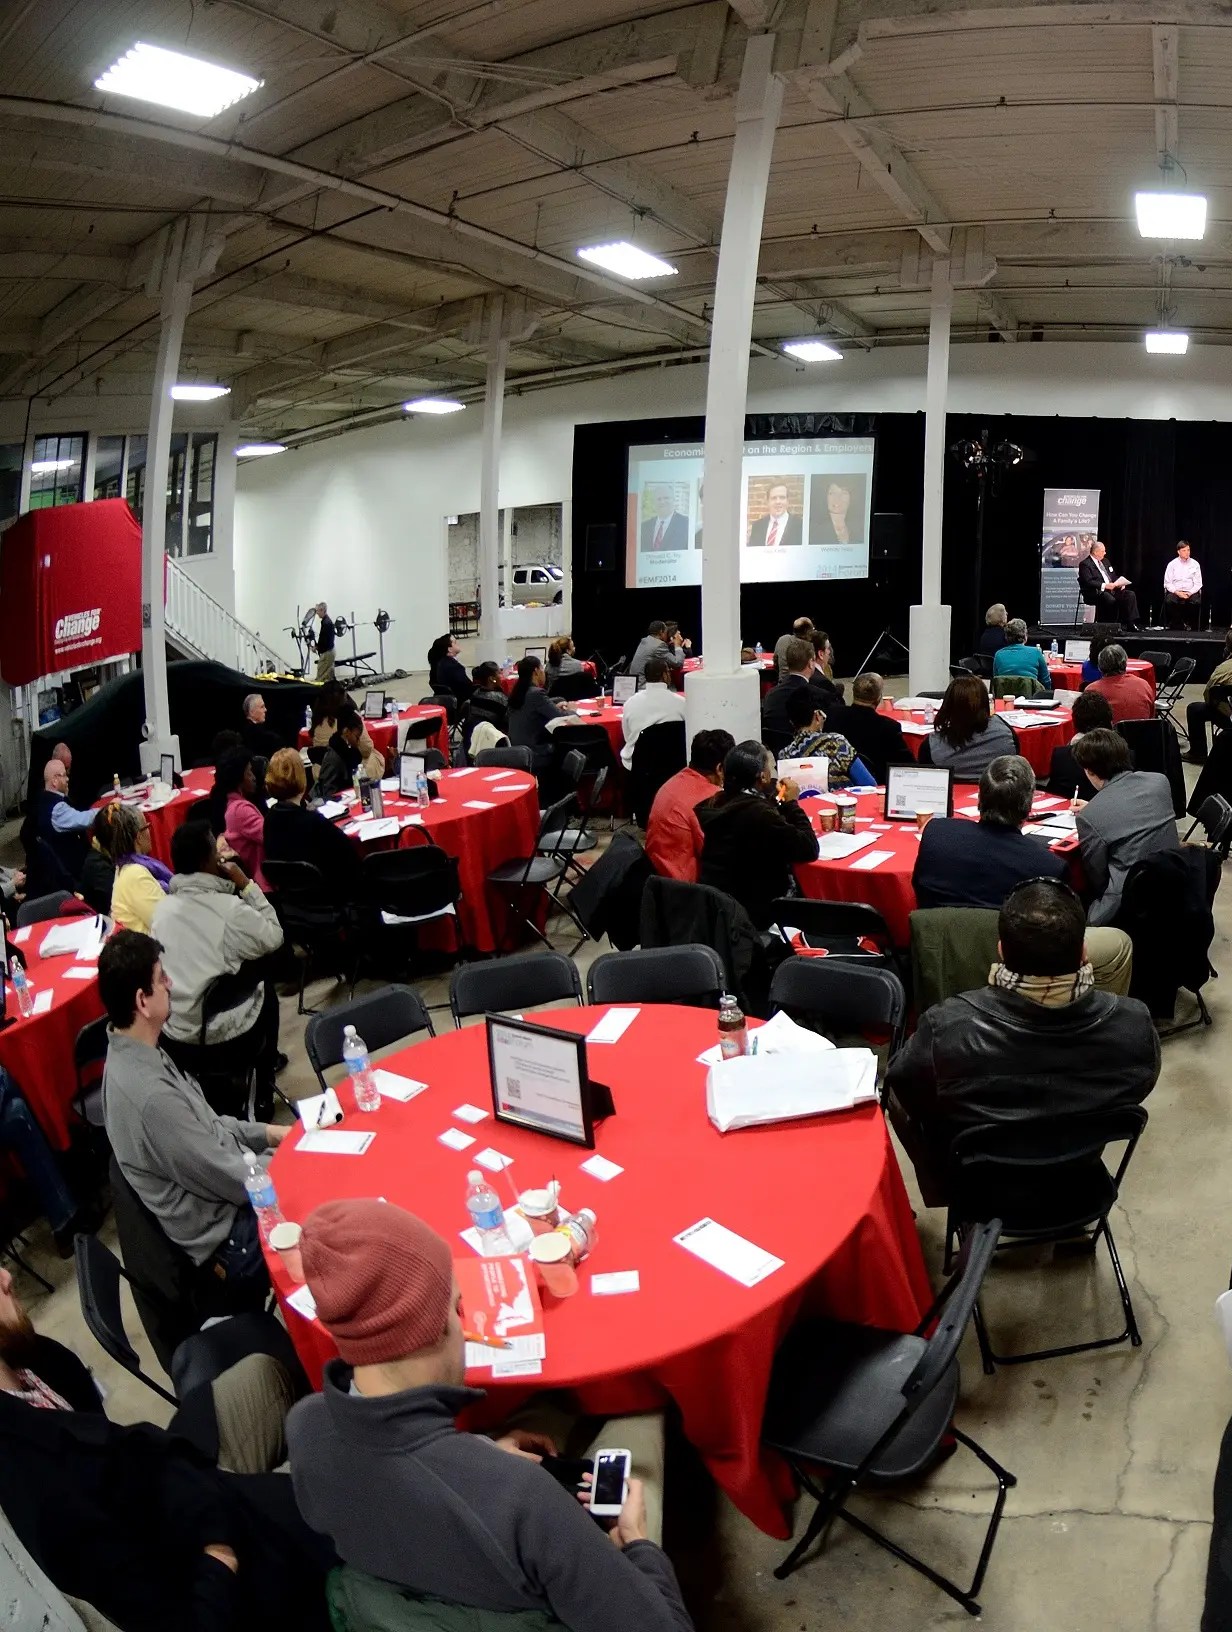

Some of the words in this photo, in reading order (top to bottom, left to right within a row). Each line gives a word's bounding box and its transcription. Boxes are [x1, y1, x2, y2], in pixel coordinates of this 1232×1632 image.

[663, 447, 704, 458] Economi
[749, 447, 760, 455] on
[762, 445, 777, 454] the
[779, 444, 812, 456] Region
[814, 445, 821, 453] &
[823, 443, 873, 455] Employers
[638, 575, 677, 585] #EMF2014
[55, 615, 100, 640] Change
